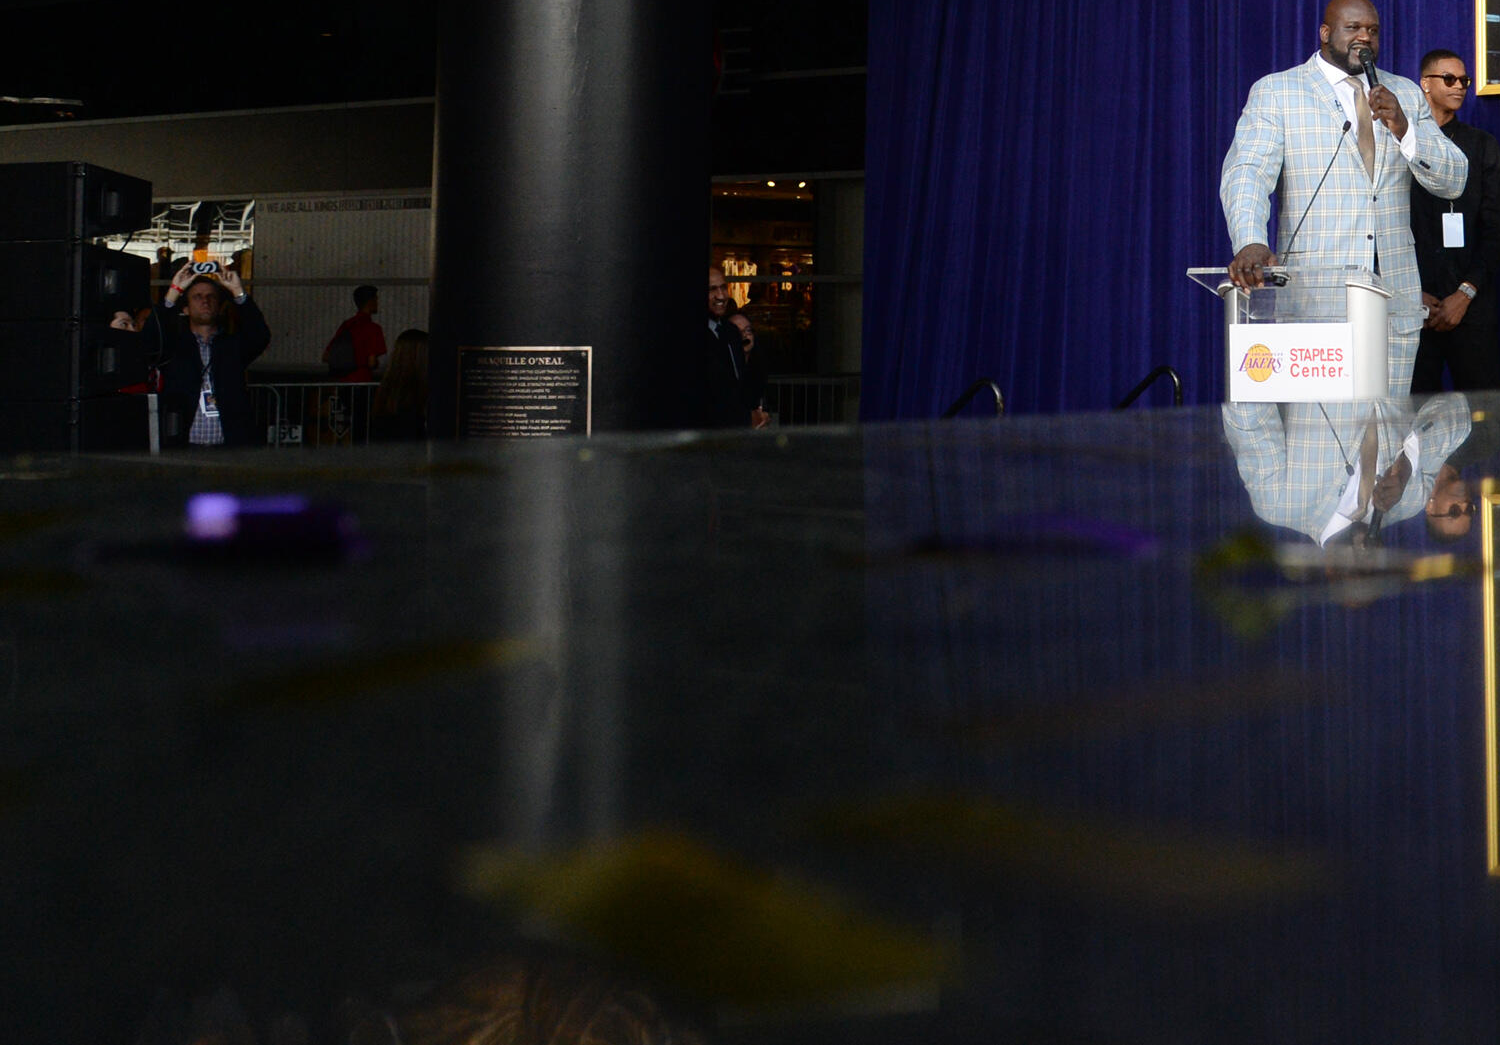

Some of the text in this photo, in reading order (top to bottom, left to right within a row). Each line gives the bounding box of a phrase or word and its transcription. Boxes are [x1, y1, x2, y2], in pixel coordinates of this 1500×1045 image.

[478, 357, 565, 366] AQUILLE O'NEAL
[1289, 348, 1344, 362] STAPLES
[1238, 353, 1283, 374] LAKERS
[1289, 363, 1344, 378] Center
